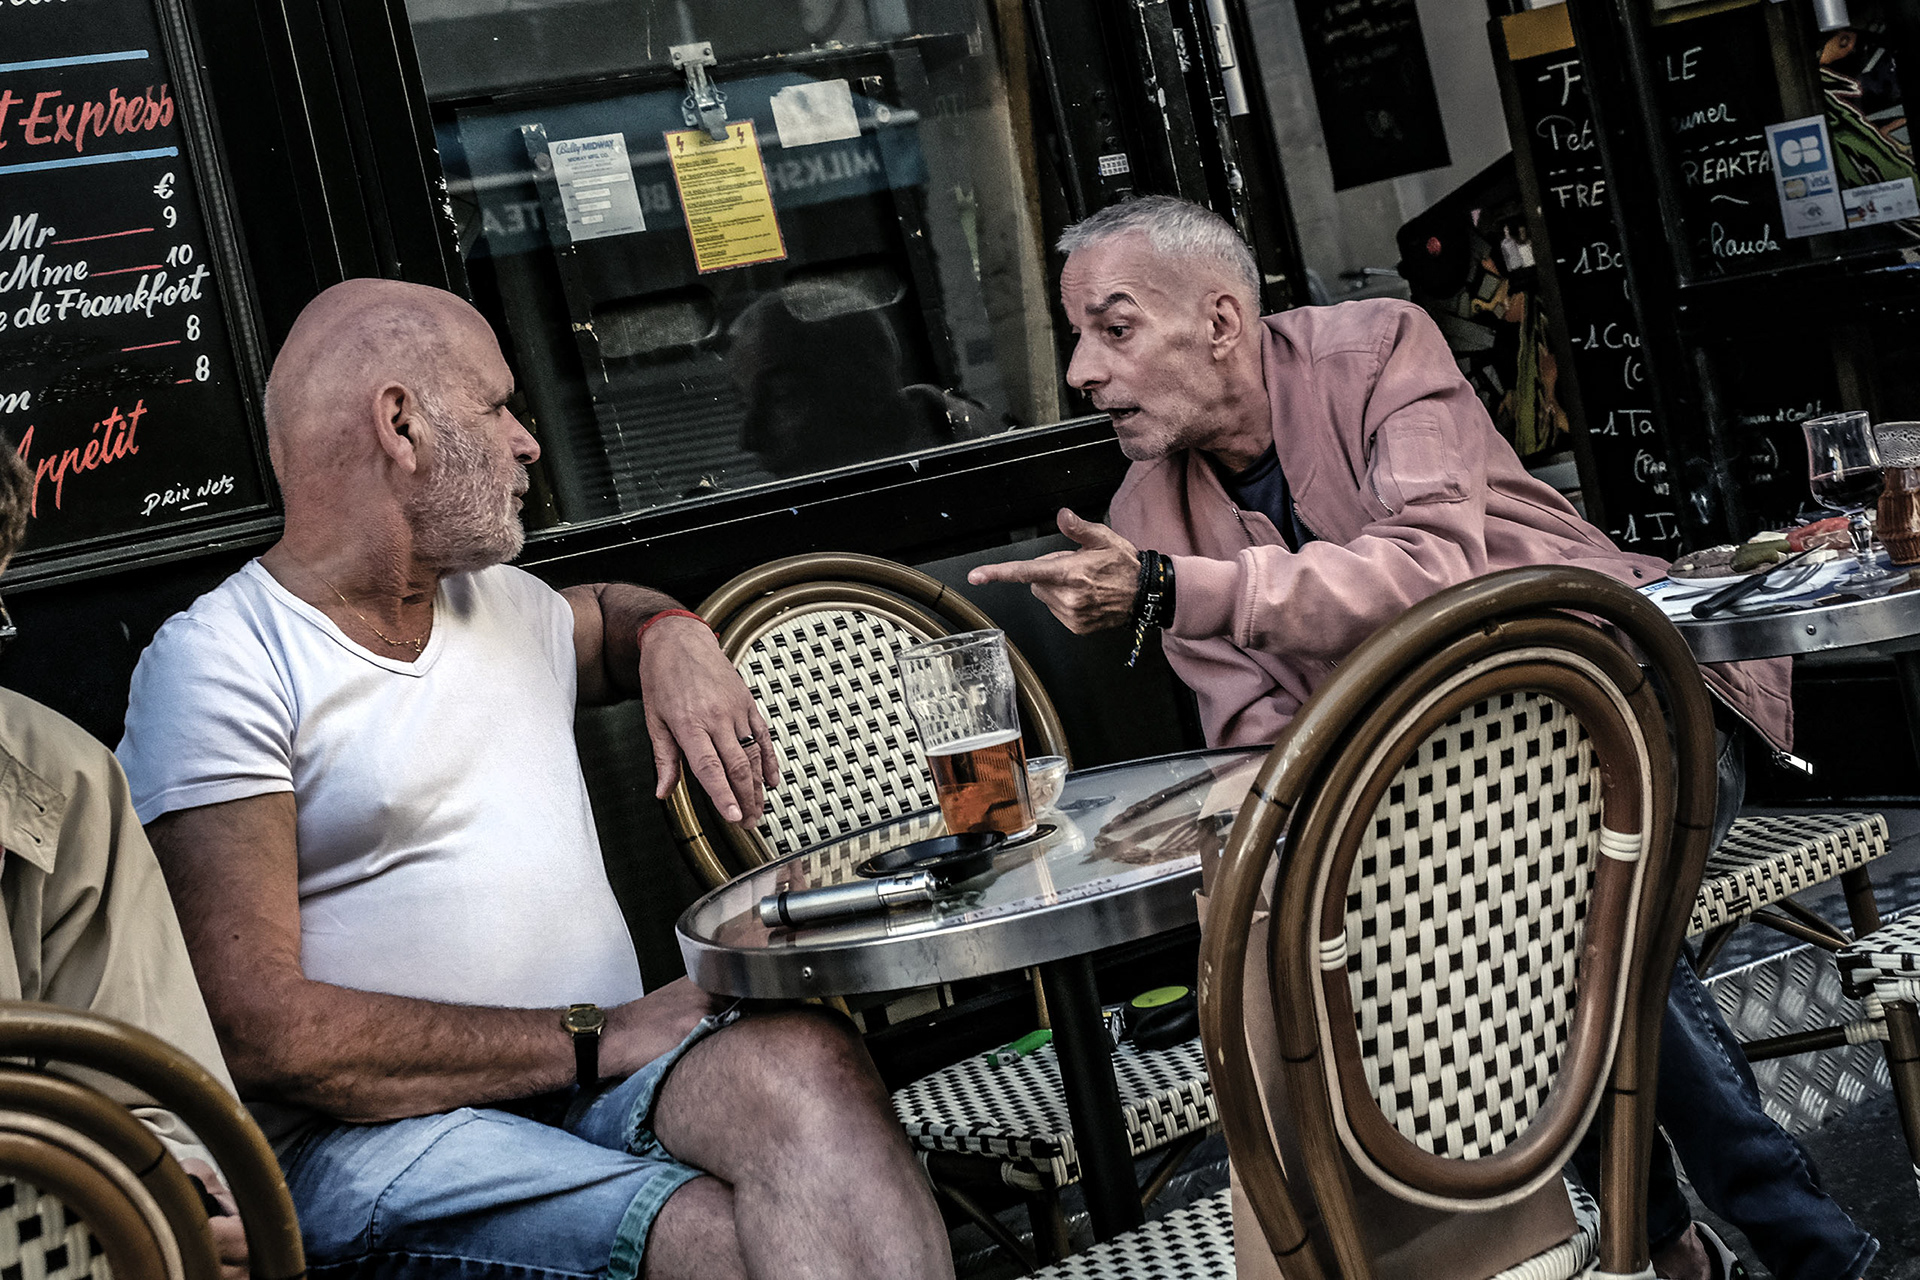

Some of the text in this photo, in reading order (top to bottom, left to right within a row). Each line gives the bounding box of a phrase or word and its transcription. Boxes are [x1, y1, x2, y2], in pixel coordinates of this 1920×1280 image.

[18, 83, 175, 152] Express
[582, 139, 615, 152] MIDWAY
[0, 205, 178, 252] Mr 9
[166, 243, 194, 268] 10
[13, 290, 51, 329] de
[54, 263, 211, 321] Frankfort
[186, 314, 202, 342] 8
[194, 354, 211, 382] 8
